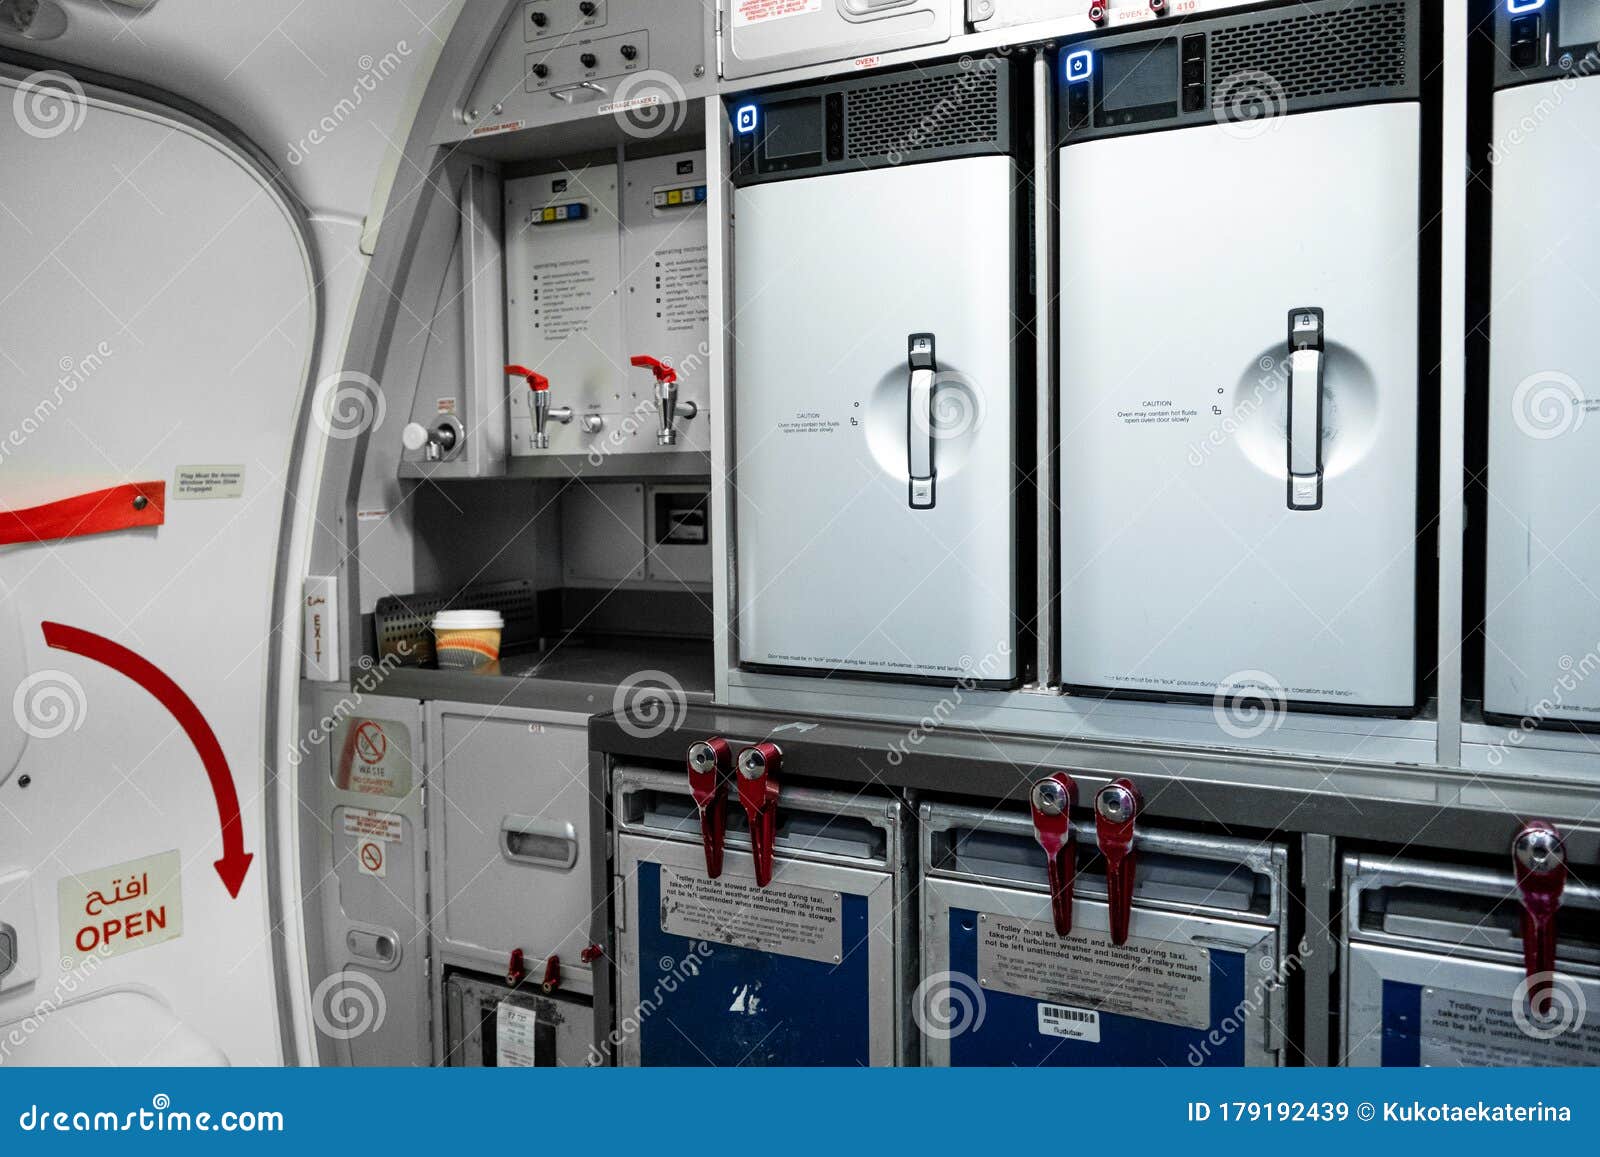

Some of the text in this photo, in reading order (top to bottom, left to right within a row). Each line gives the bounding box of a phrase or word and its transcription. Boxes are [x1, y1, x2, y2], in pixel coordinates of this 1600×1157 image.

[1176, 2, 1194, 12] 410
[856, 58, 874, 66] OVEN
[358, 766, 385, 777] WASTE
[86, 872, 148, 916] افتح
[676, 874, 695, 883] Trolley
[724, 883, 747, 891] stowed
[762, 888, 786, 897] secured
[788, 893, 808, 902] during
[696, 886, 722, 895] turbulent
[725, 890, 749, 899] weather
[793, 901, 814, 911] Trolley
[700, 894, 733, 905] unattended
[735, 900, 752, 908] when
[753, 903, 780, 913] removed
[781, 908, 796, 916] from
[76, 905, 166, 952] OPEN
[997, 923, 1021, 934] Trolley
[1024, 928, 1042, 937] must
[1059, 934, 1088, 944] stowed
[1090, 939, 1105, 947] and
[1108, 942, 1139, 953] secured
[1140, 946, 1166, 959] during
[984, 939, 997, 947] not
[1000, 941, 1009, 949] be
[1011, 942, 1023, 951] left
[1026, 947, 1069, 959] unattended
[1072, 953, 1094, 963] when
[1096, 958, 1129, 969] removed
[1132, 963, 1151, 973] from
[1023, 937, 1057, 948] turbulent
[1060, 943, 1092, 954] weather
[1147, 957, 1175, 968] Trolley
[1176, 963, 1198, 972] must
[1449, 1000, 1482, 1014] Trolley
[1452, 1021, 1464, 1030] be
[1469, 1023, 1486, 1034] left
